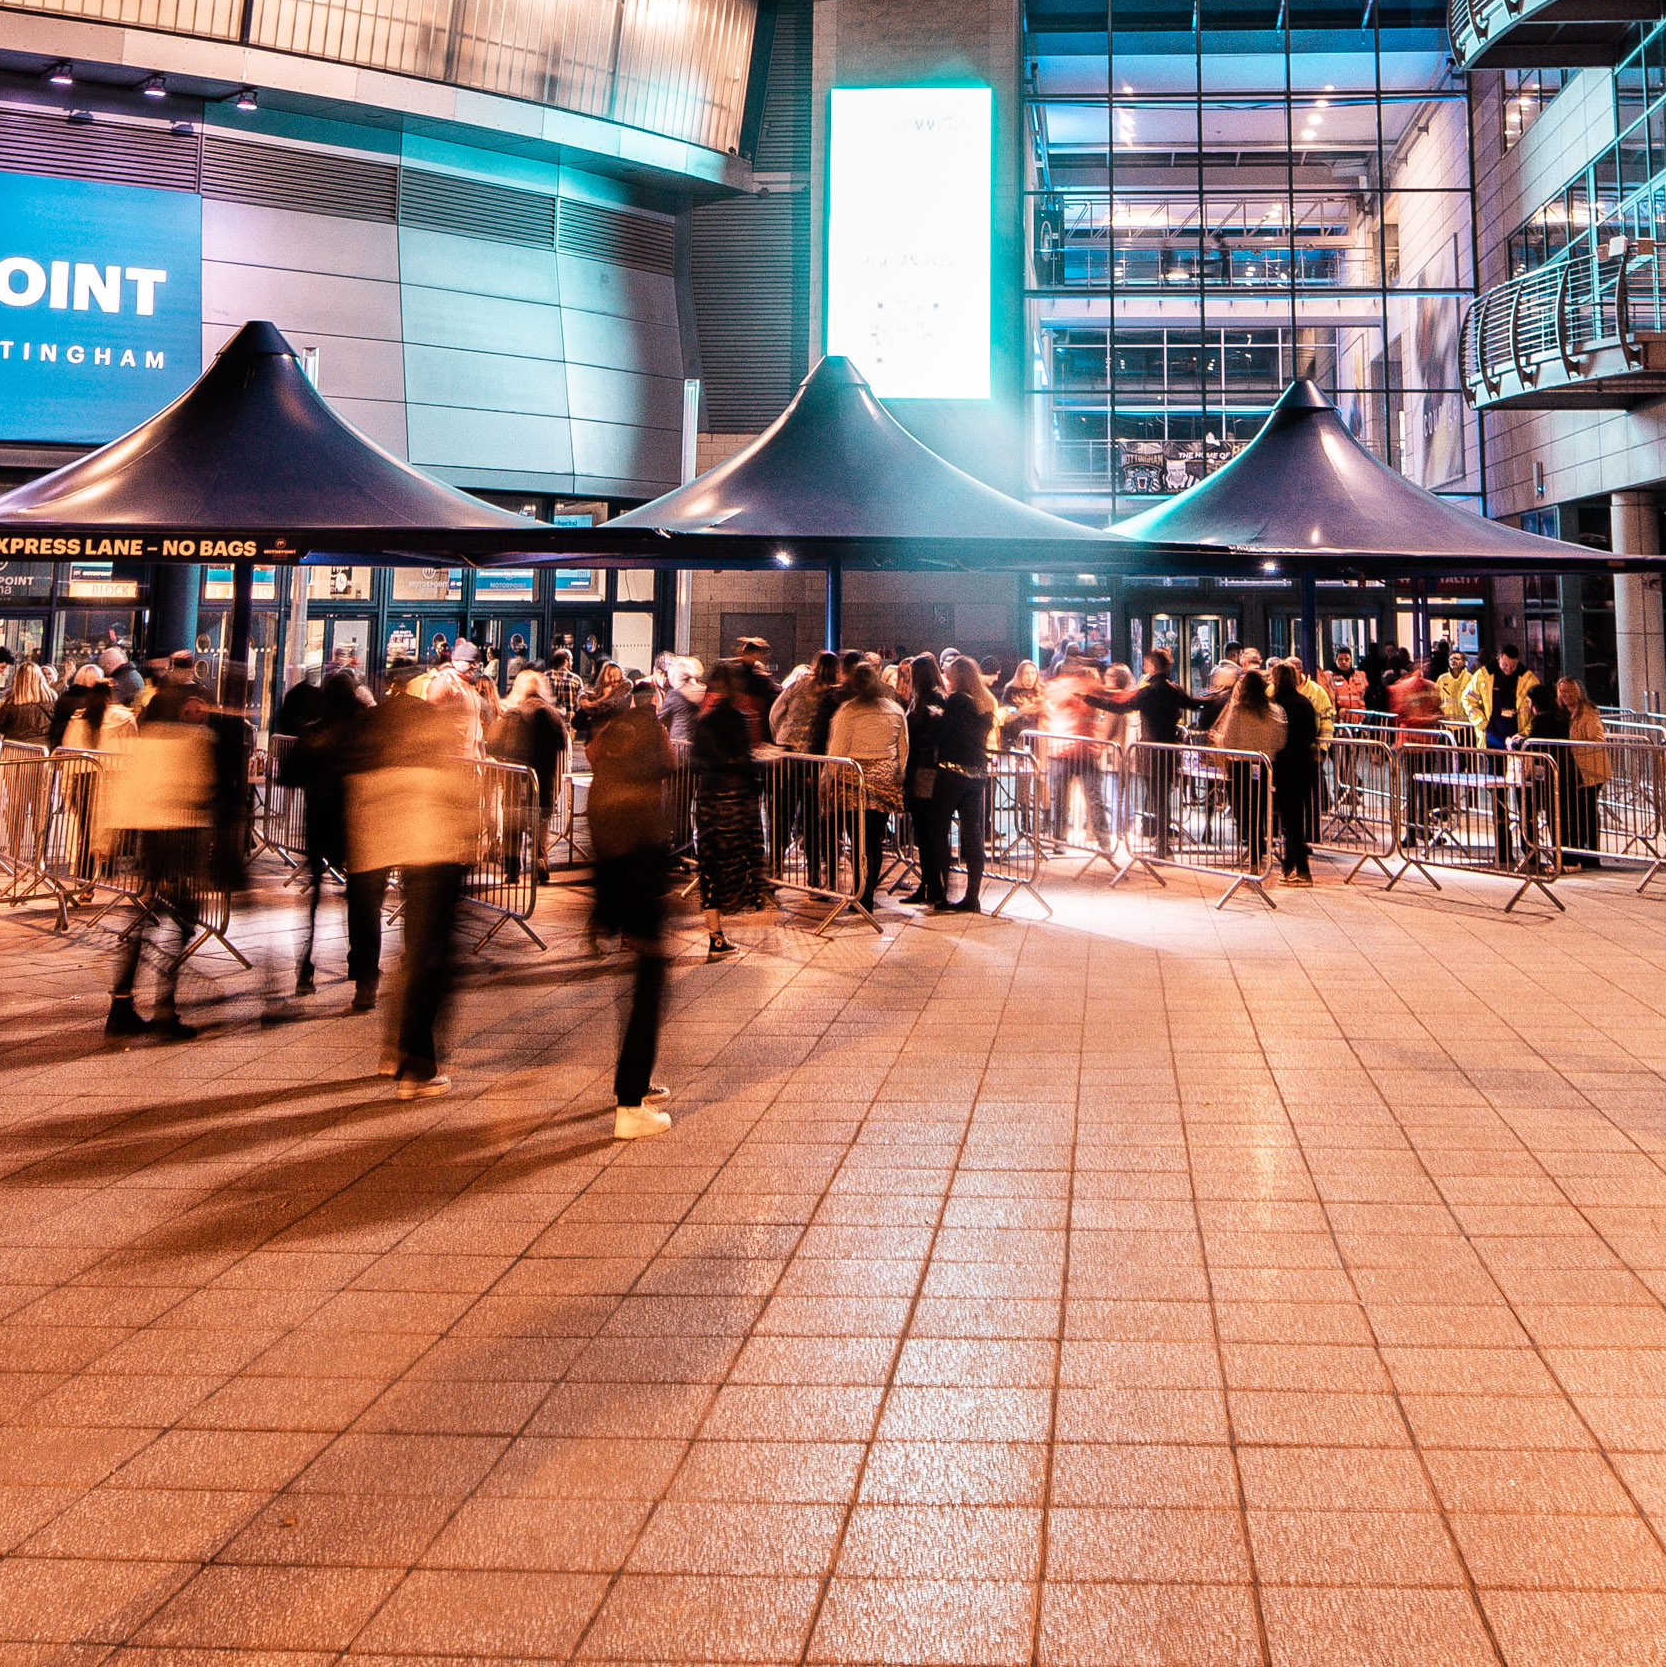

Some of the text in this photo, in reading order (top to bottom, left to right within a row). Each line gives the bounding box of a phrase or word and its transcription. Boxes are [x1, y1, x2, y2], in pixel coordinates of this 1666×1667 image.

[85, 539, 143, 556] LANE
[162, 540, 196, 557] NO
[199, 540, 257, 557] BAGS
[92, 585, 129, 596] BLOCK
